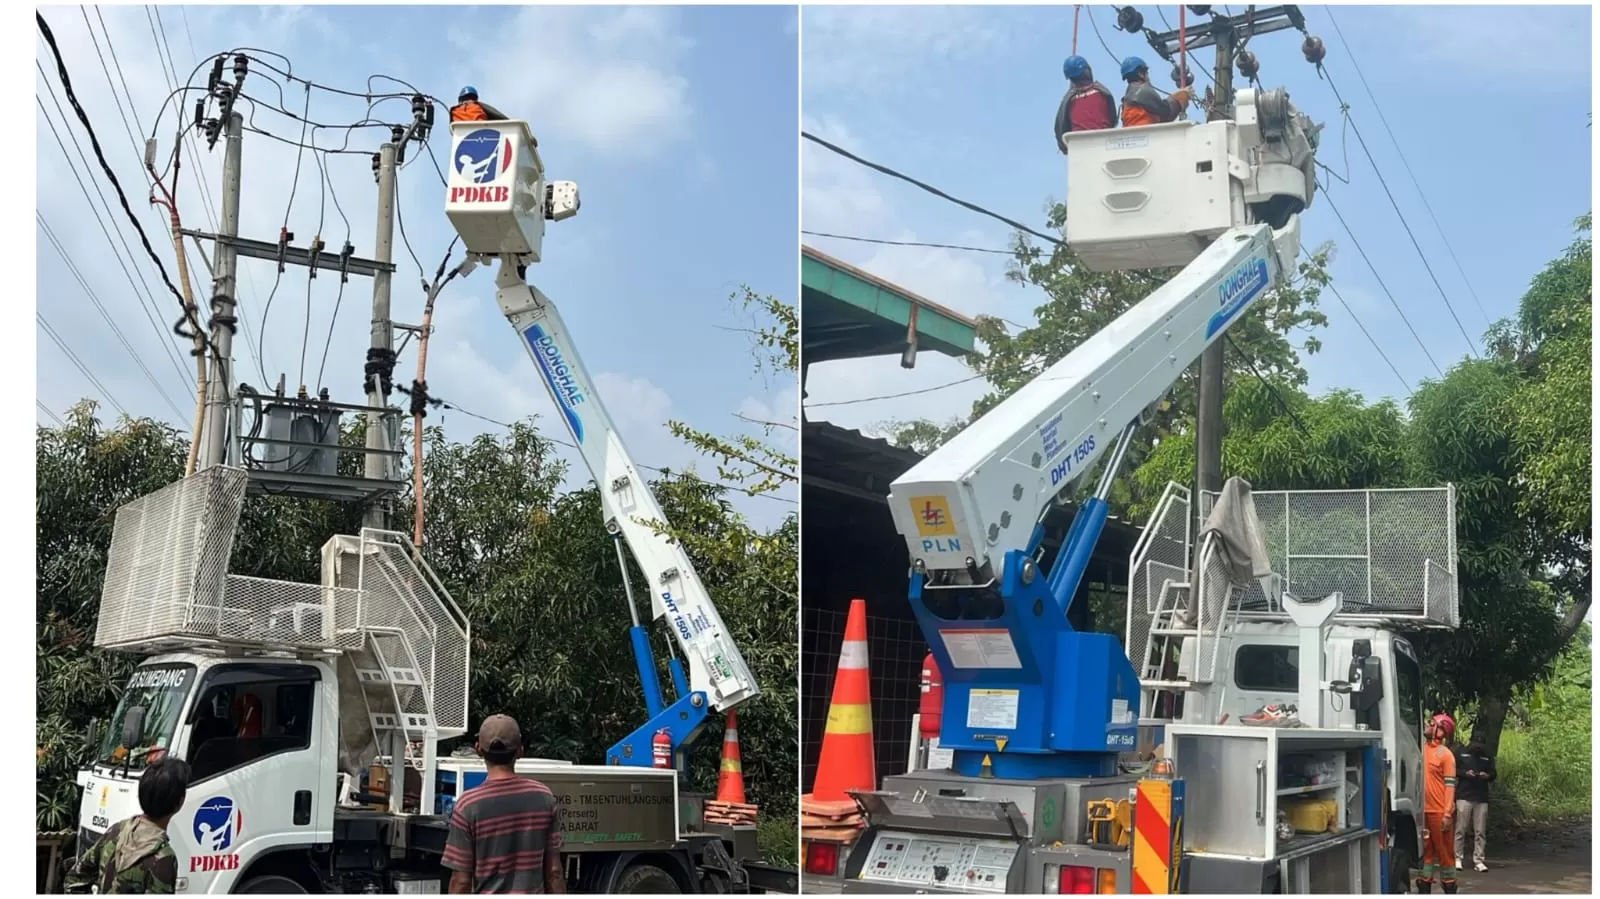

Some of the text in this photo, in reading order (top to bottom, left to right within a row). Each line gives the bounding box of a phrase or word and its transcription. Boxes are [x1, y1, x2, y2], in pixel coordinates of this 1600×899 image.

[450, 186, 509, 203] PDKB
[1219, 256, 1261, 306] DONGHAE
[539, 334, 585, 406] DONGHAE
[1051, 434, 1095, 486] DHT 150S
[922, 538, 961, 553] PLN
[661, 592, 692, 640] DHT 150S
[136, 669, 187, 688] SUMEDANG
[558, 808, 598, 822] (Persero)
[568, 821, 599, 832] BARAT
[189, 854, 240, 872] PDKB
